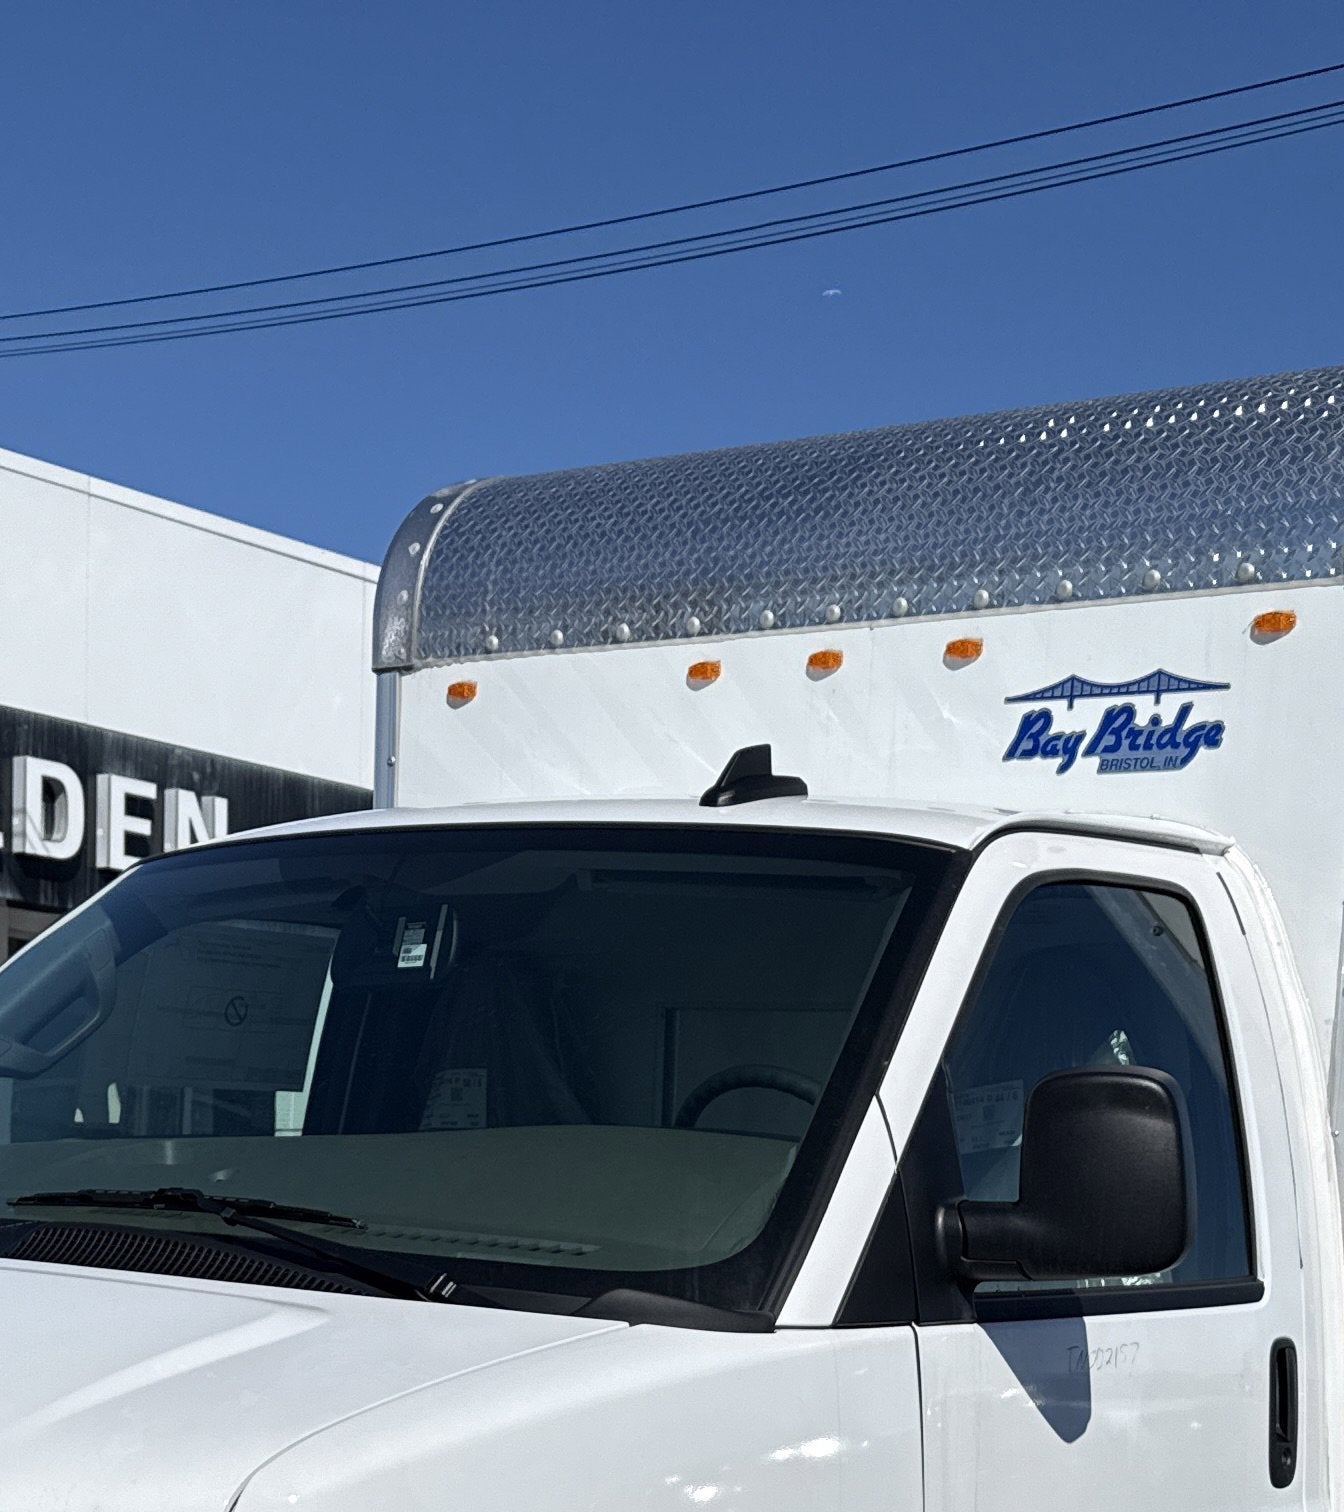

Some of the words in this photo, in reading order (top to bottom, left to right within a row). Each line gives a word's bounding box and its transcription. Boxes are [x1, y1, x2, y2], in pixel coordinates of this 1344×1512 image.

[1003, 707, 1086, 774] Bay
[1082, 702, 1225, 767] Bridge
[1163, 755, 1180, 769] IN
